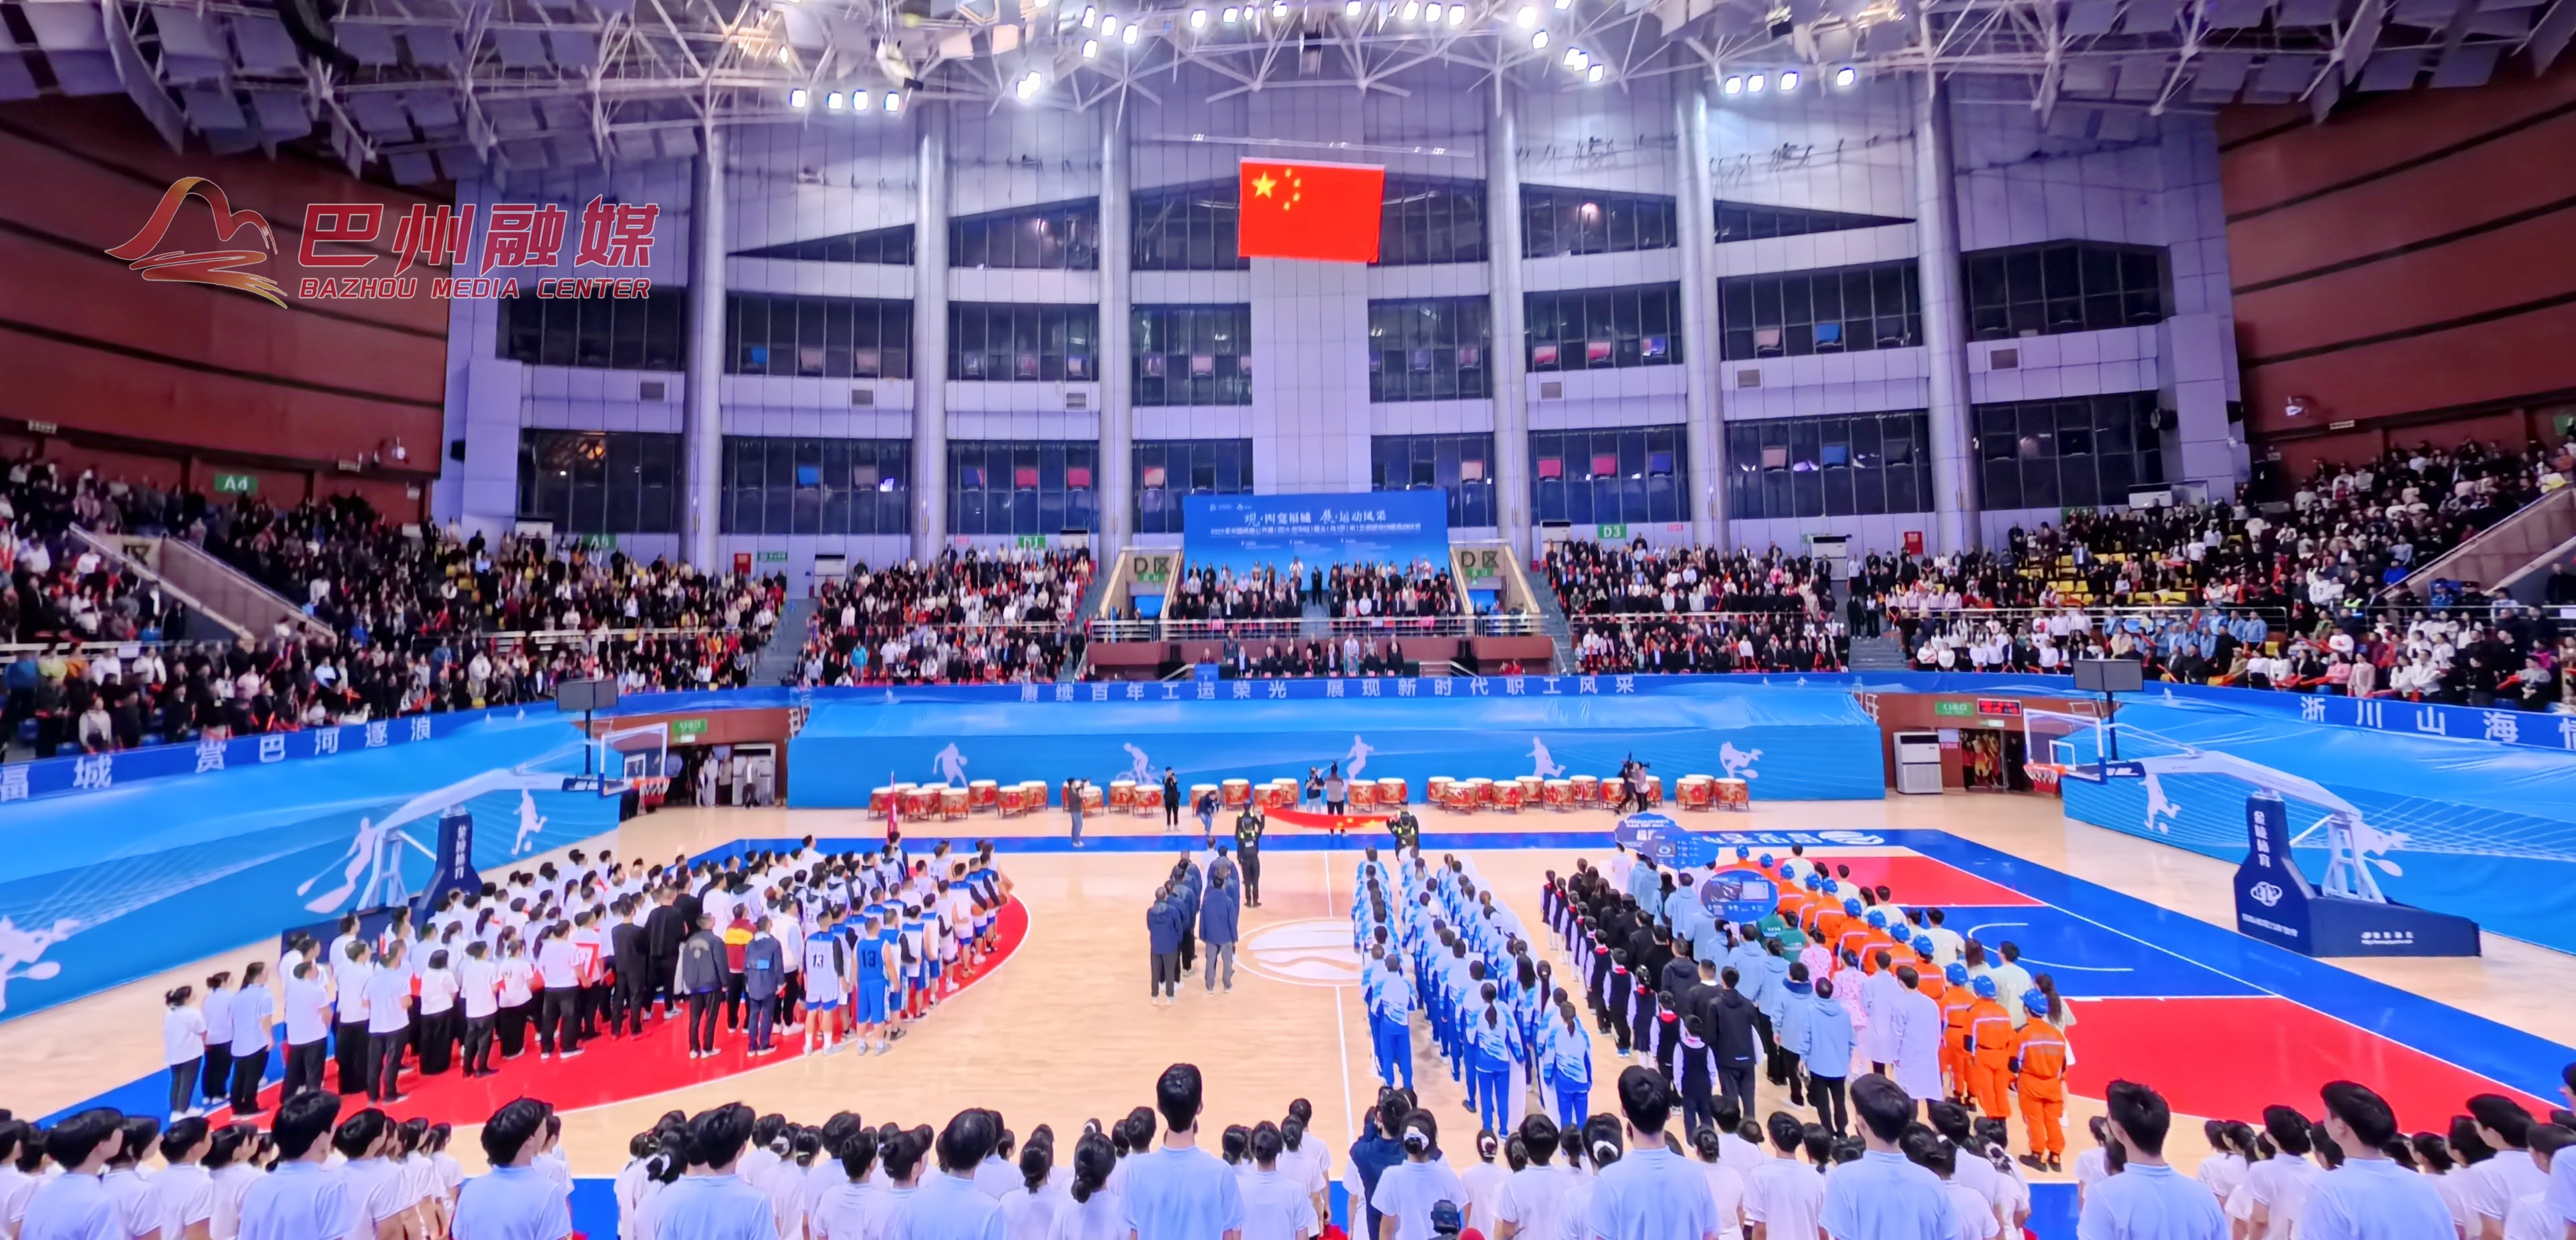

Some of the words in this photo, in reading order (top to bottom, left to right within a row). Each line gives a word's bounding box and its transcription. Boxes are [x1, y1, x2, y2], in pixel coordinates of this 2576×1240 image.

[1603, 525, 1621, 538] D3
[1327, 677, 1634, 699] 展现新时代职工风采
[195, 717, 431, 773] 赏巴河逐浪
[813, 953, 824, 969] 13
